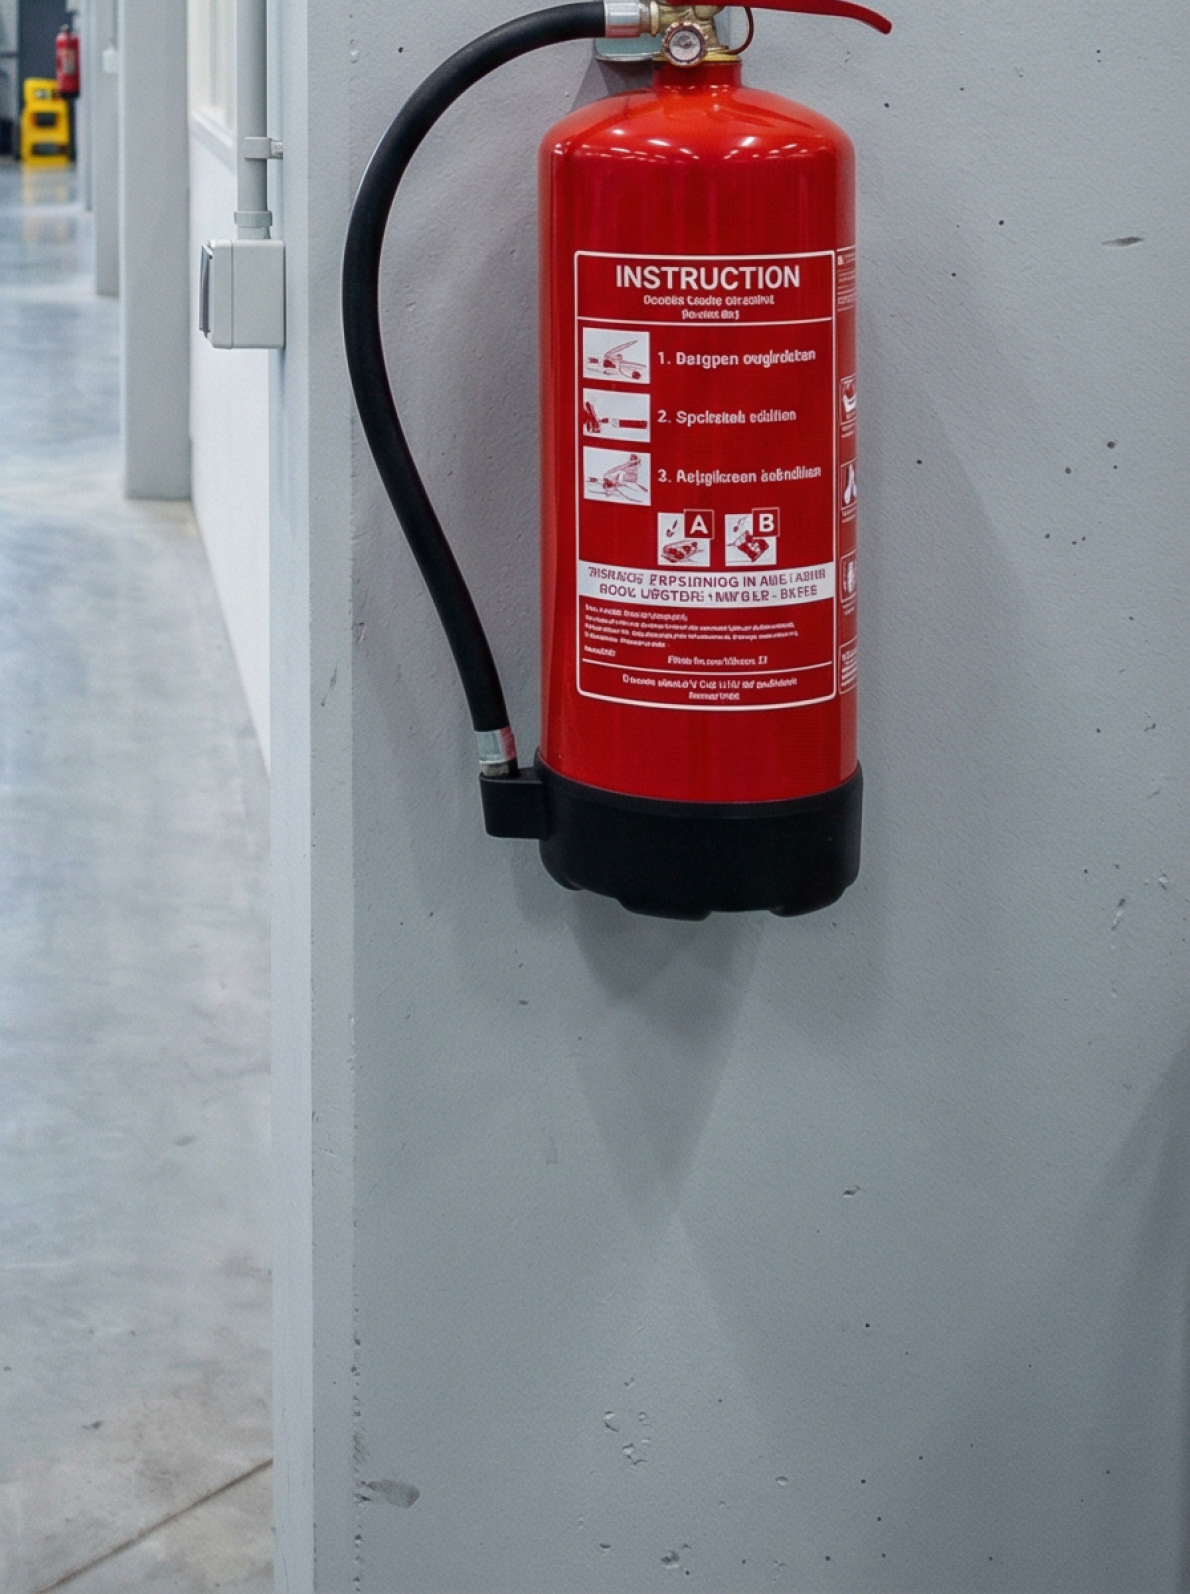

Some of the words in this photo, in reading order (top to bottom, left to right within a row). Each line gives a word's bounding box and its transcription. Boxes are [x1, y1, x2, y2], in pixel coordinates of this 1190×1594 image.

[615, 265, 801, 291] INSTRUCTION
[657, 351, 672, 365] 1.
[656, 409, 672, 424] 2.
[657, 468, 672, 483] 3.
[689, 514, 709, 535] A
[758, 513, 775, 533] B
